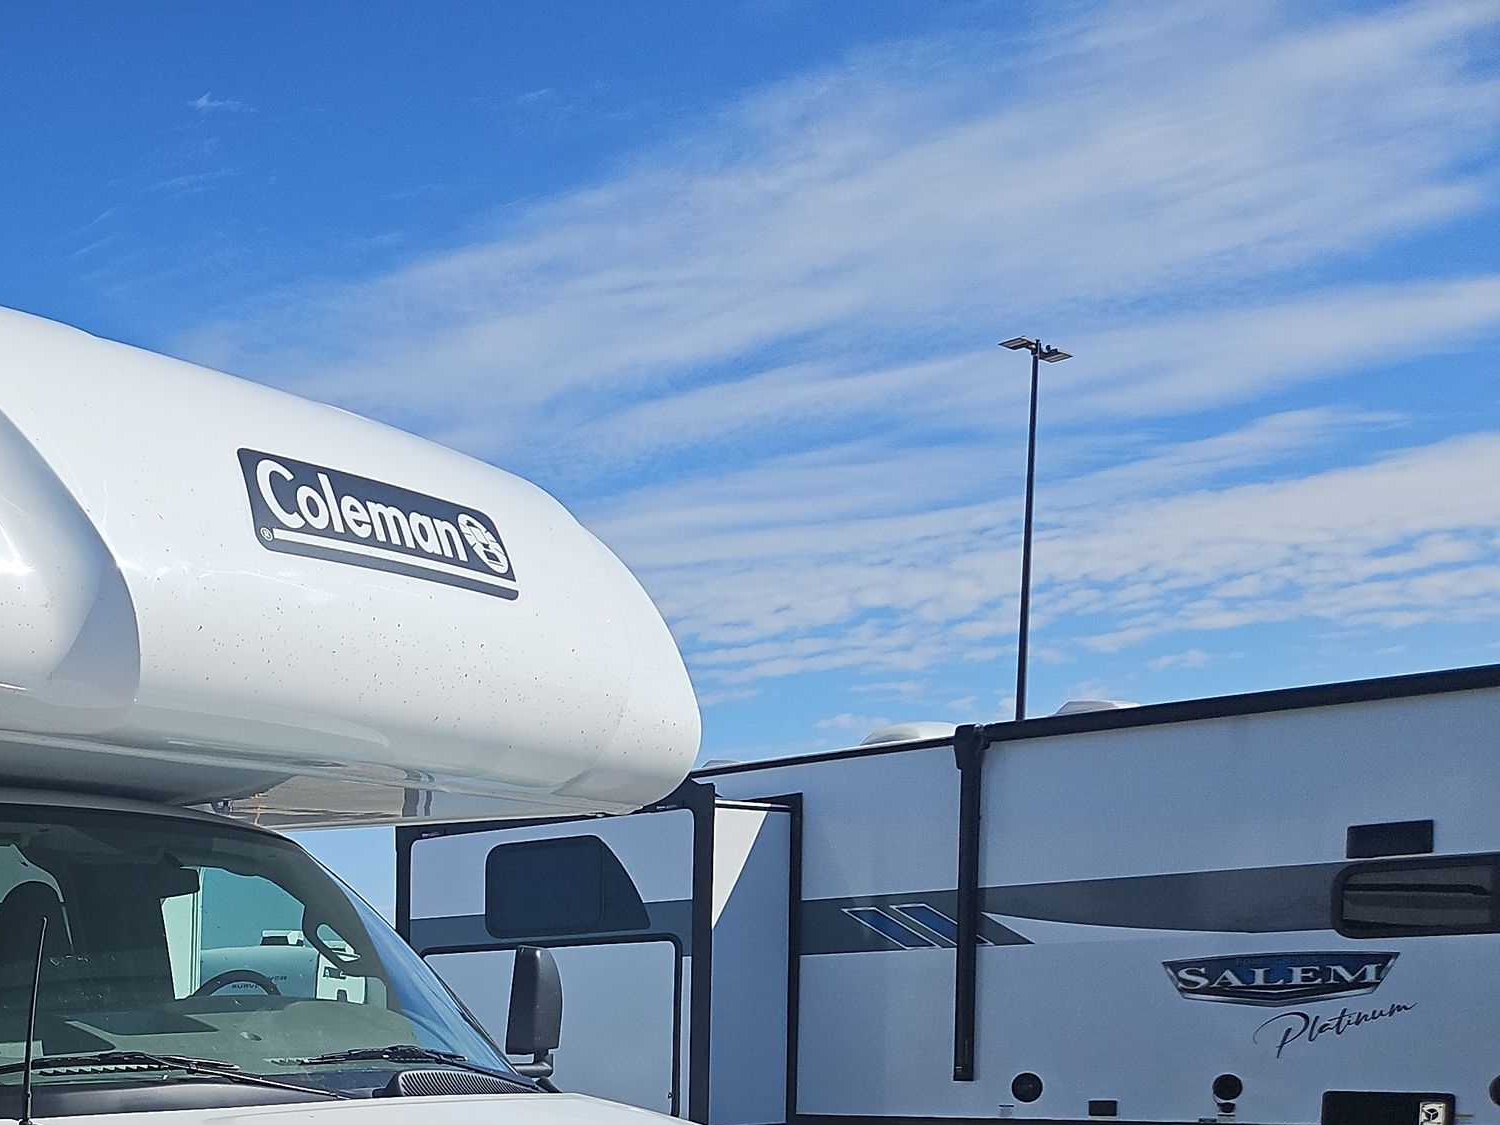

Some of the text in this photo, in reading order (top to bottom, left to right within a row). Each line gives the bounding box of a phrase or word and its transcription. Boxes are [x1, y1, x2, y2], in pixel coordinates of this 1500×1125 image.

[256, 459, 469, 562] Coleman
[1176, 963, 1383, 991] SALEM
[1252, 1001, 1418, 1059] Platinum
